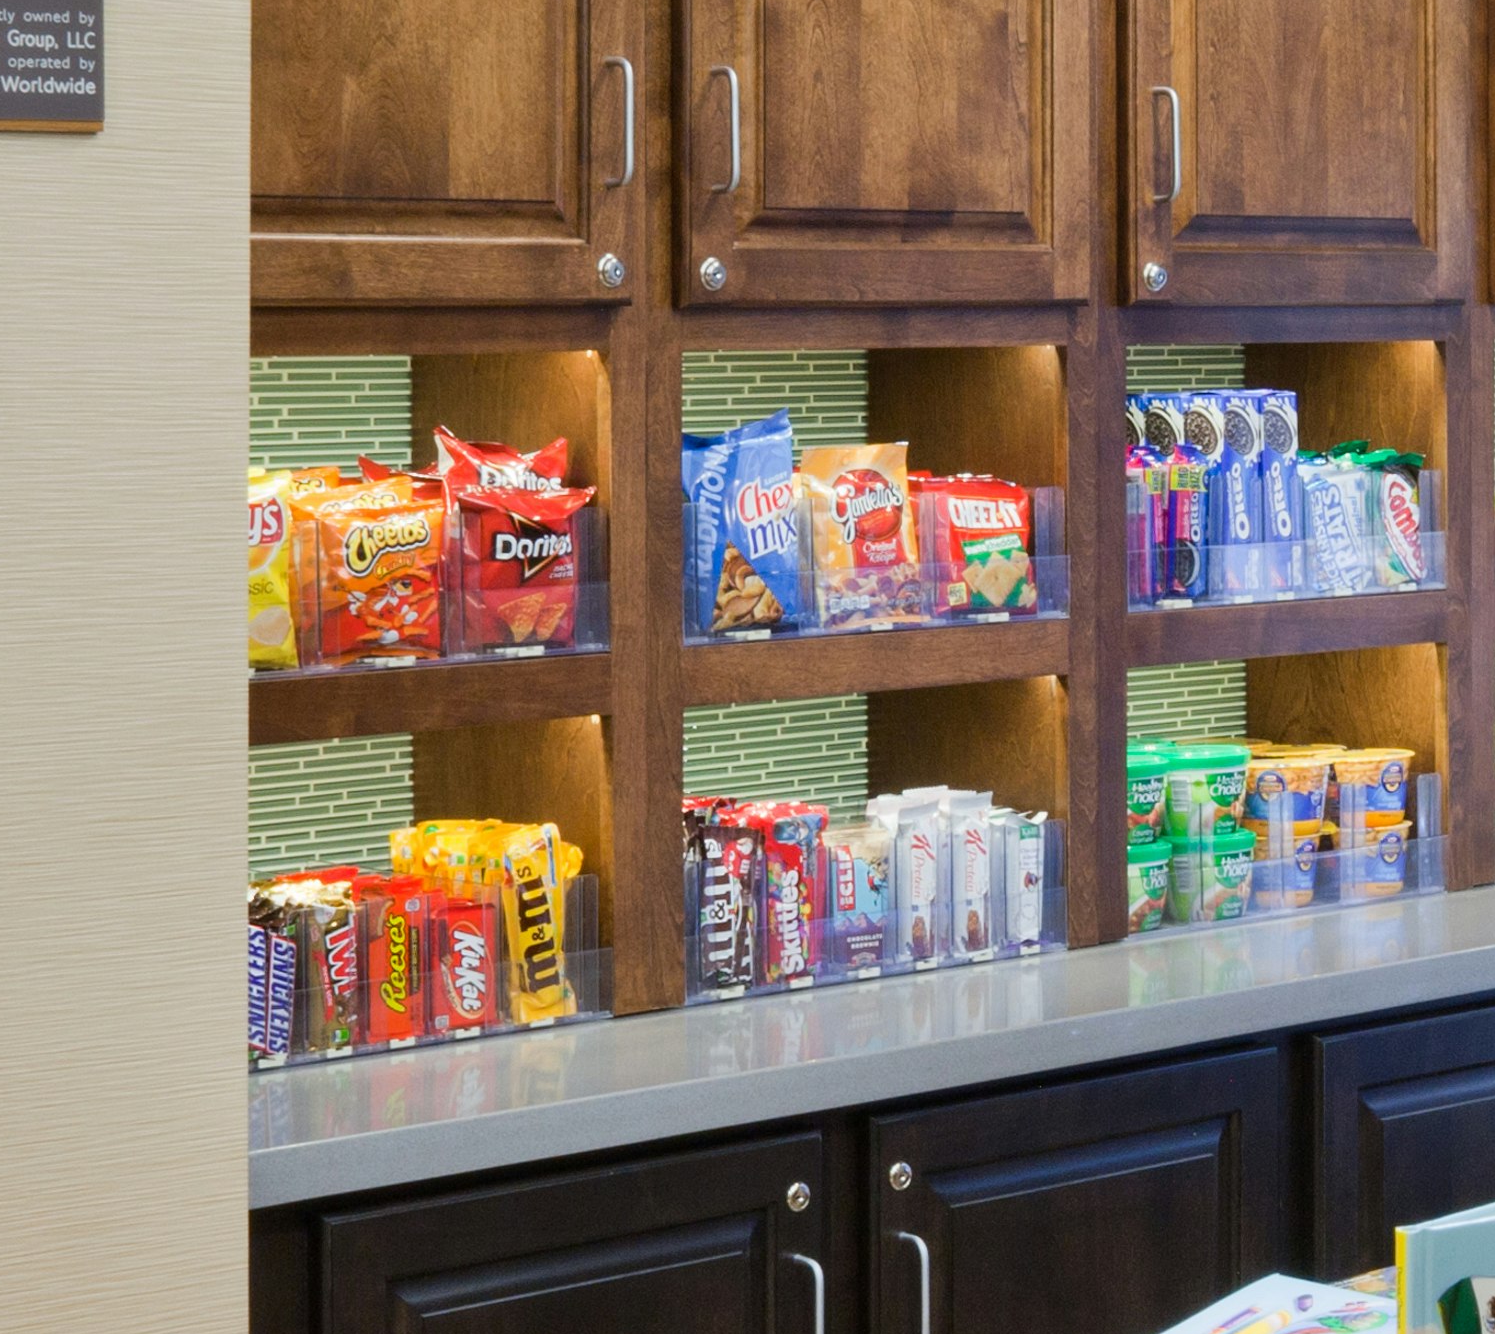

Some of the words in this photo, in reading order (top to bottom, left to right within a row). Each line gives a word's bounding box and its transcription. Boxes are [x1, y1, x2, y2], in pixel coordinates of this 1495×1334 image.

[7, 29, 59, 49] Group,
[67, 31, 96, 49] LLC
[23, 10, 70, 23] owned
[79, 12, 95, 25] by
[0, 75, 96, 94] Worldwide
[8, 56, 70, 71] operated
[79, 57, 95, 72] by
[738, 478, 794, 523] Chex
[947, 497, 1022, 529] CHEEZ-IT
[1190, 492, 1201, 542] OREO
[1231, 462, 1250, 540] OREO
[1270, 461, 1292, 537] OREO
[347, 516, 429, 574] Cheetos
[495, 532, 573, 560] Doritos
[776, 868, 804, 975] Skittles
[380, 913, 407, 1013] Reese's
[269, 938, 296, 1054] SNICKERS
